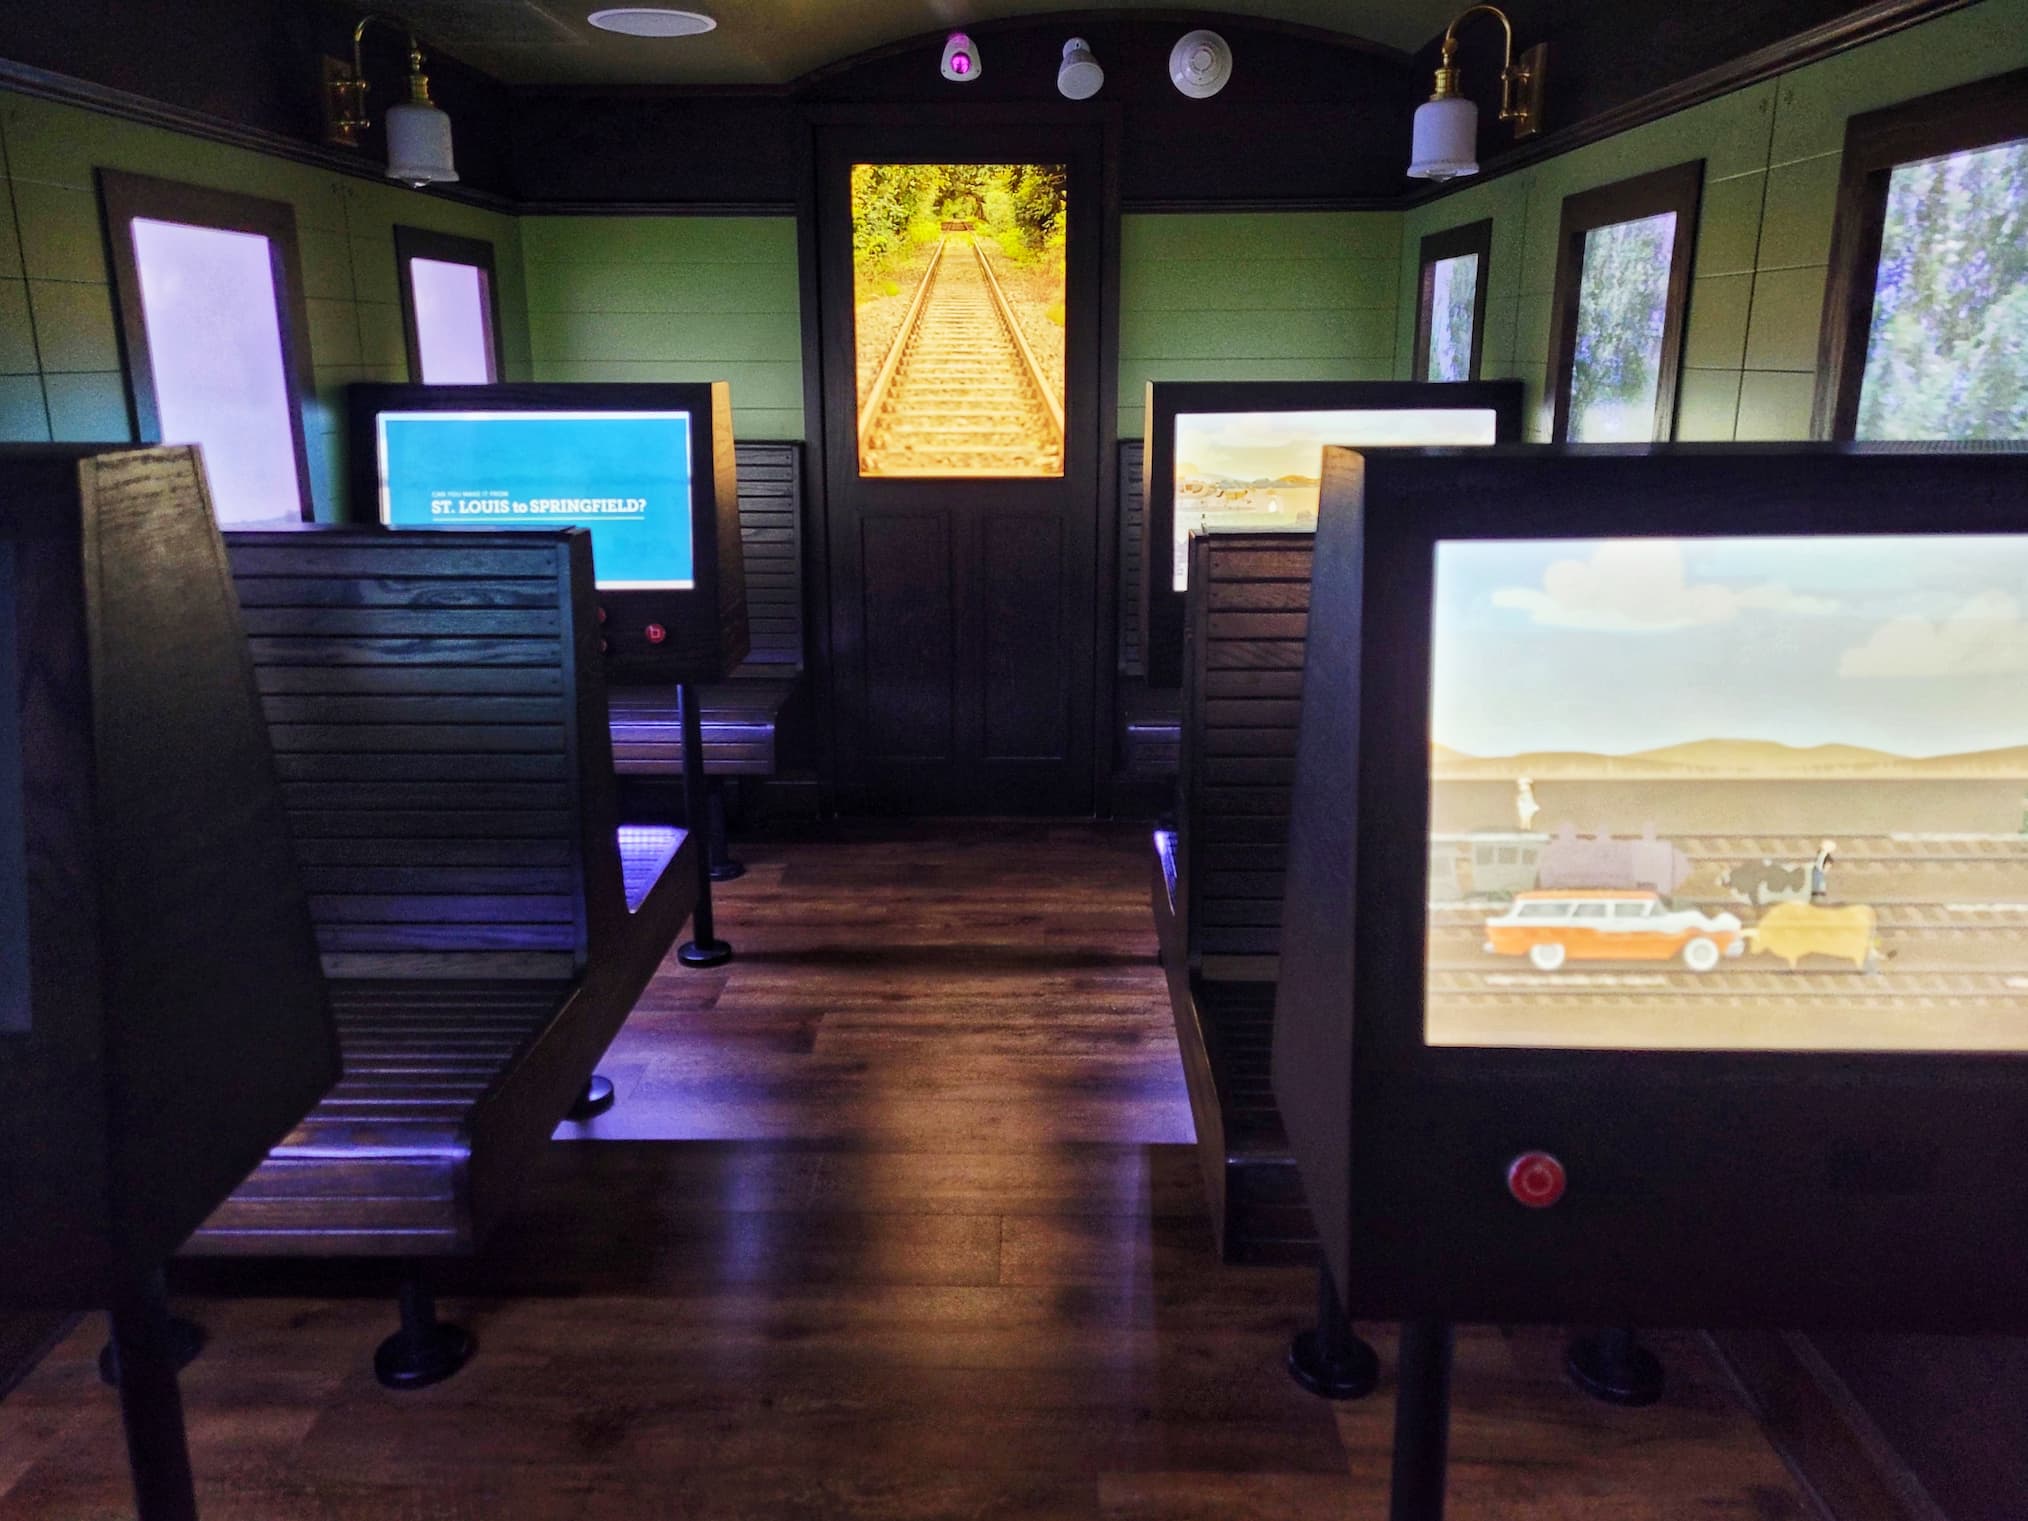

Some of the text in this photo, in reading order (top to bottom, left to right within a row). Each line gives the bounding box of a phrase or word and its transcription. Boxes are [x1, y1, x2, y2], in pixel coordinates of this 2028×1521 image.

[431, 498, 647, 514] ST. LOUIS to SPRINGFIELD?
